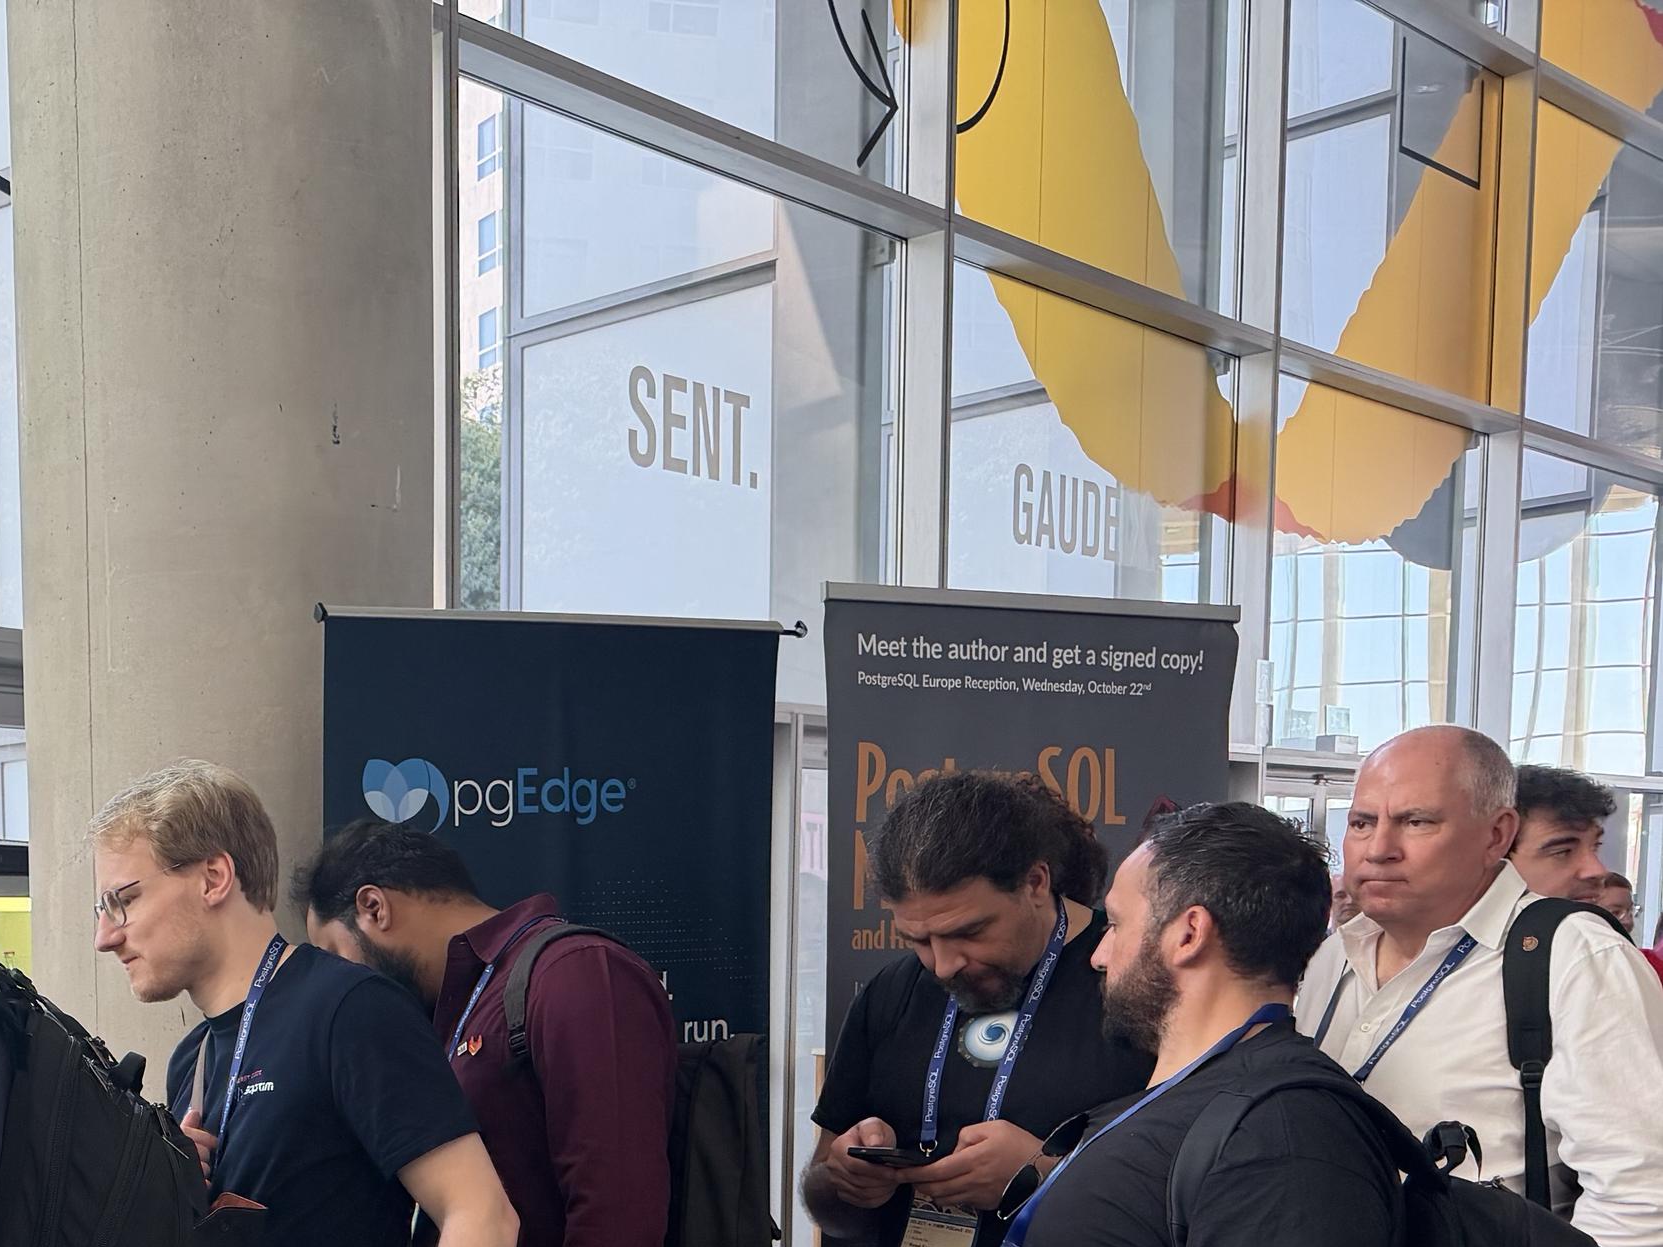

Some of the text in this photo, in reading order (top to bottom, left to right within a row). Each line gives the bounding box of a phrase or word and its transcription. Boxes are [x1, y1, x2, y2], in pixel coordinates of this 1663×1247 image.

[627, 365, 758, 490] SENT.
[857, 632, 1204, 675] Meet the author and get a signed copy!
[857, 671, 1152, 696] PostgreSQL Europe Reception, Wednesday, October 22nd
[851, 919, 886, 950] and
[254, 941, 284, 988] PostgreSQL
[1028, 952, 1057, 1004] PostgreSQL
[1410, 961, 1456, 1008] PostgreSQL
[934, 1010, 955, 1059] PostgreSQL
[1004, 1013, 1032, 1065] PostgreSQL
[924, 1068, 940, 1122] PostgreSQL
